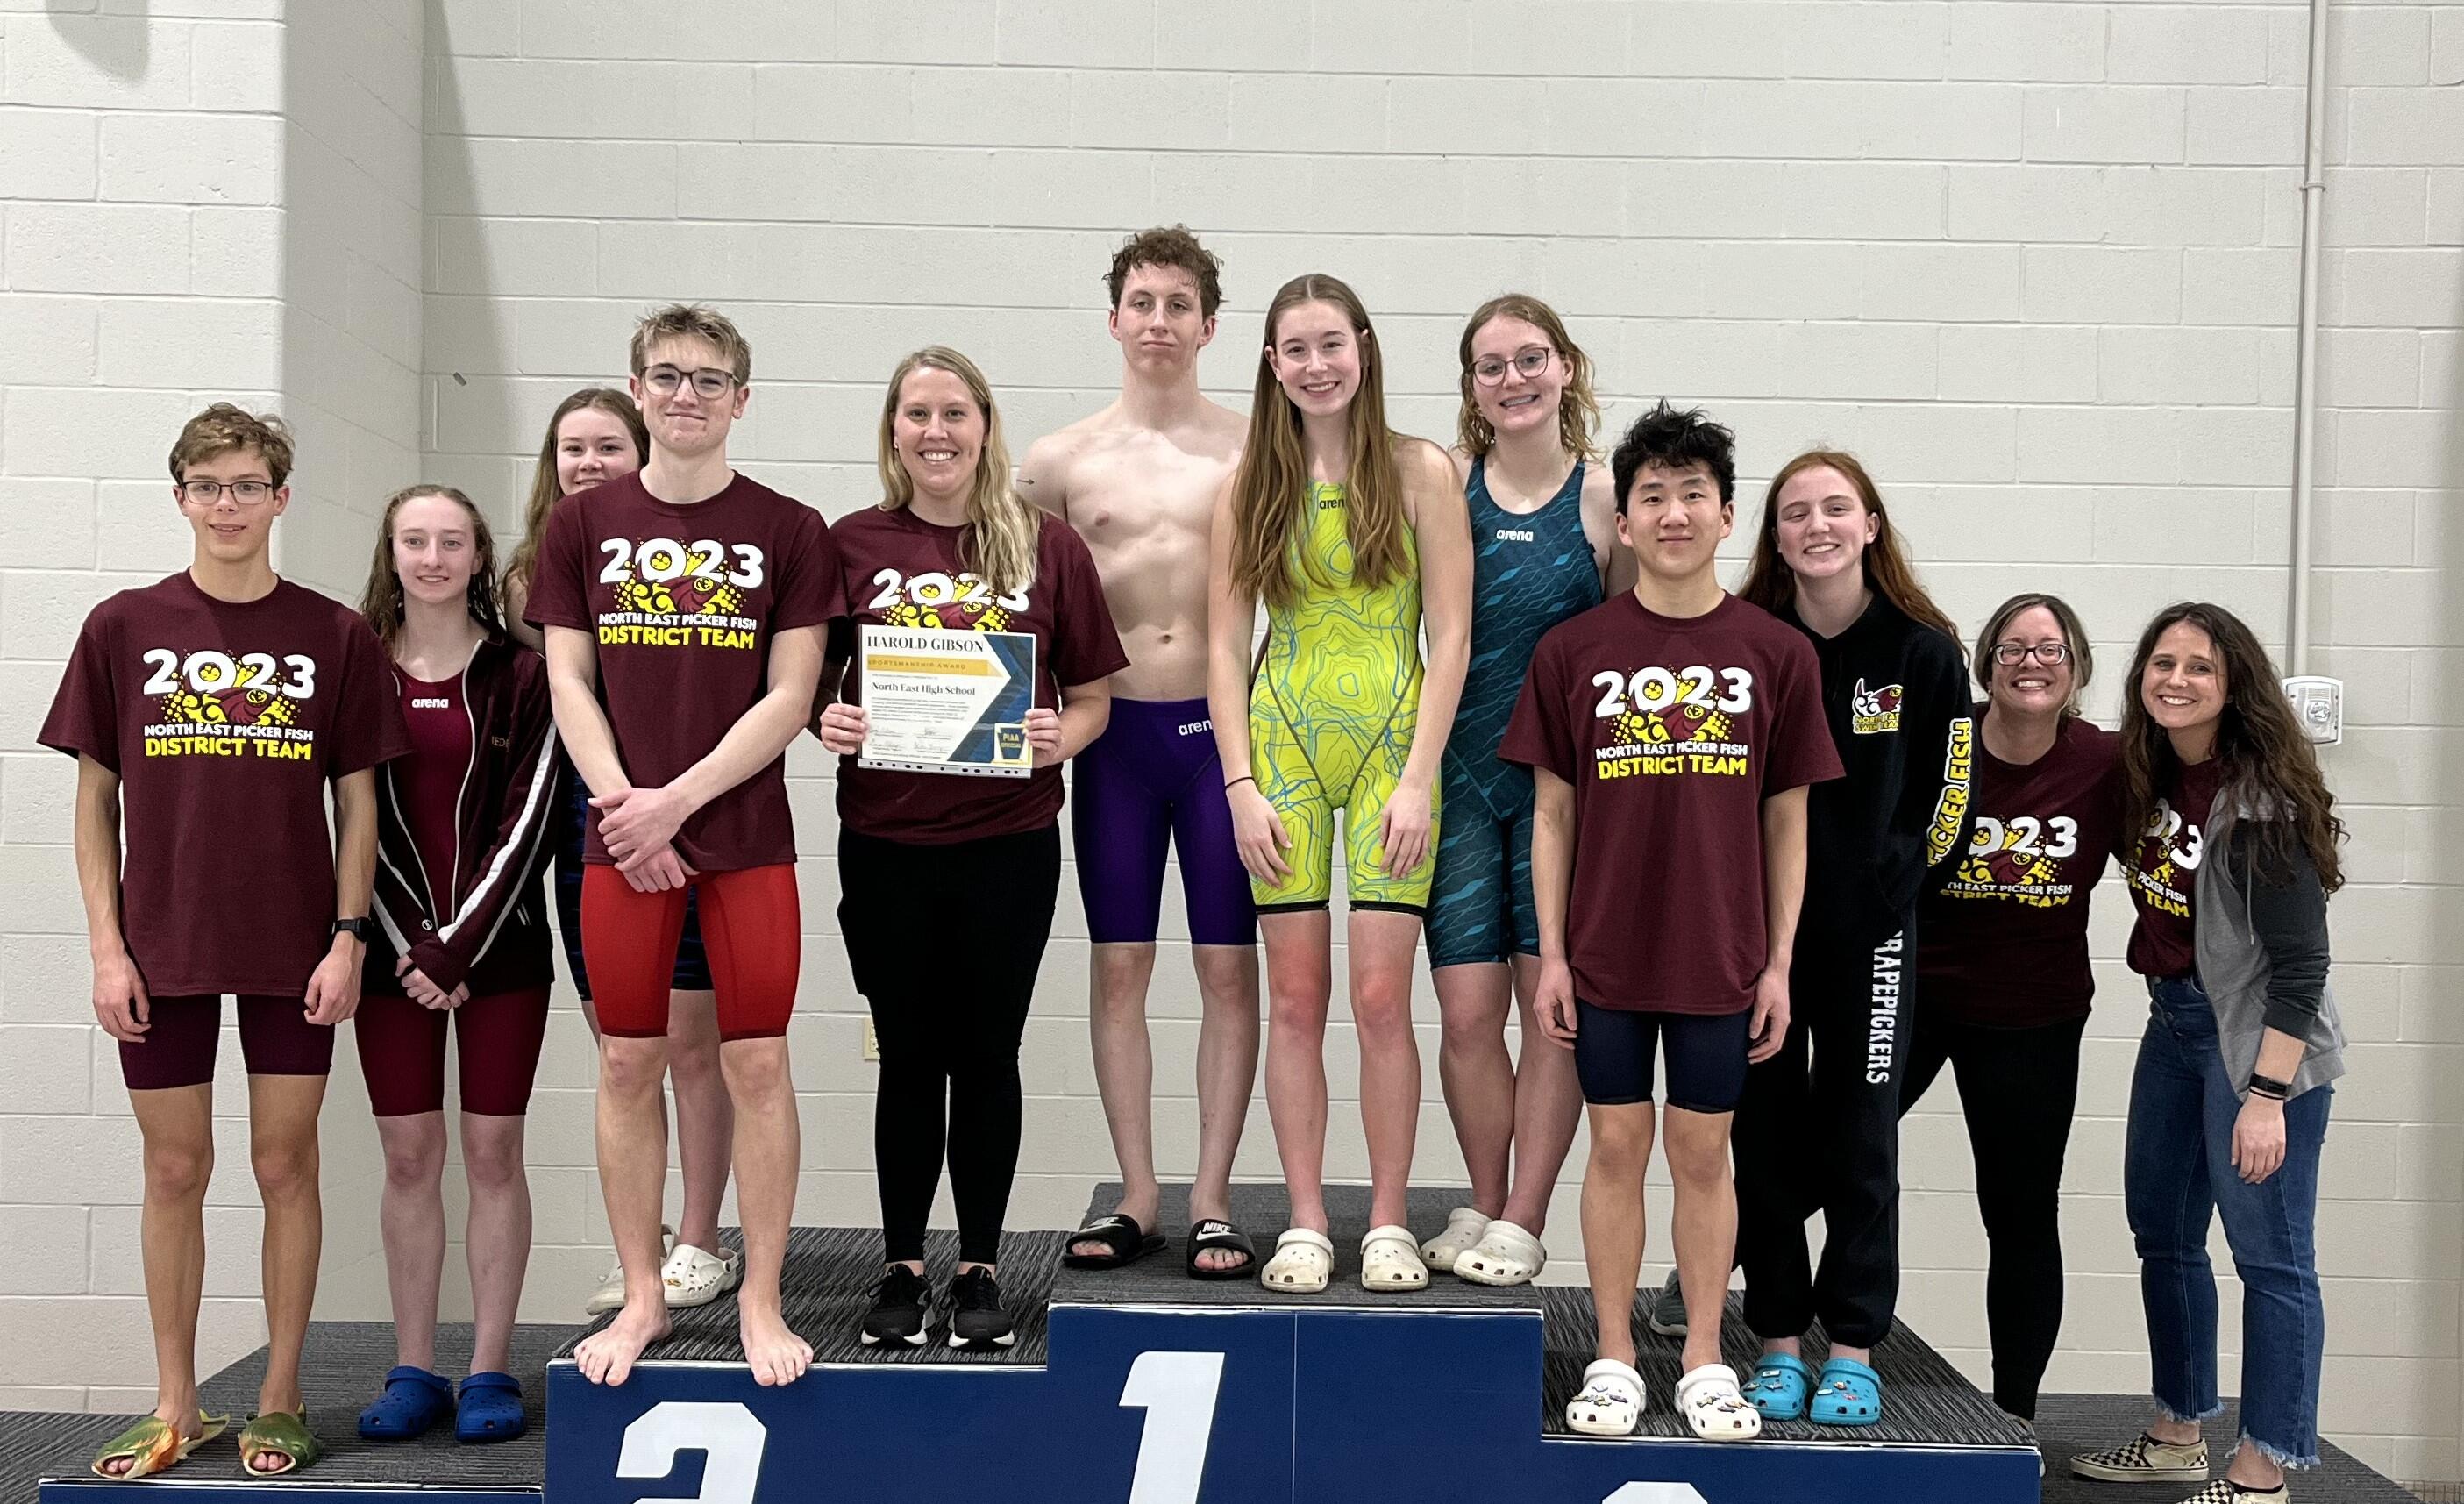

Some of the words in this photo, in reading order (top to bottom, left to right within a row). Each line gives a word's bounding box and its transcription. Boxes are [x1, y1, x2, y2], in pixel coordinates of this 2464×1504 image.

[1320, 499, 1344, 509] aren
[1497, 529, 1534, 541] arena
[600, 538, 764, 588] 2023
[599, 612, 642, 625] NORTH
[645, 613, 679, 626] EAST
[682, 614, 728, 627] PICKER
[730, 617, 757, 631] FISH
[599, 626, 693, 646] DISTRICT
[698, 628, 755, 650] TEAM
[867, 636, 927, 649] HAROLD
[931, 638, 983, 652] GIBSON
[142, 648, 316, 699] 2023
[872, 682, 899, 691] North
[901, 683, 919, 693] East
[922, 685, 943, 695] High
[945, 686, 976, 695] School
[1592, 666, 1753, 718] 2023
[412, 699, 449, 709] arena
[144, 723, 195, 737] NORTH
[196, 723, 231, 736] EAST
[233, 725, 282, 738] PICKER
[284, 728, 314, 741] FISH
[1179, 720, 1212, 736] aren
[145, 737, 246, 756] DISTRICT
[253, 738, 312, 760] TEAM
[1595, 744, 1641, 760] NORTH
[1644, 743, 1675, 755] EAST
[1720, 744, 1748, 756] FISH
[1947, 719, 1971, 781] FISH
[1598, 756, 1684, 780] DISTRICT
[1688, 754, 1747, 776] TEAM
[1927, 785, 1969, 866] PICKER
[1969, 816, 2078, 858] 023
[1964, 882, 1997, 892] EAST
[2000, 884, 2043, 895] PICKER
[2046, 884, 2073, 895] FISH
[2165, 888, 2188, 904] FISH
[2016, 893, 2070, 909] TEAM
[2145, 888, 2190, 918] TEAM
[1866, 930, 1904, 1084] RAPEPICKERS
[1202, 1222, 1232, 1235] NIKE
[1119, 1351, 1225, 1504] 1
